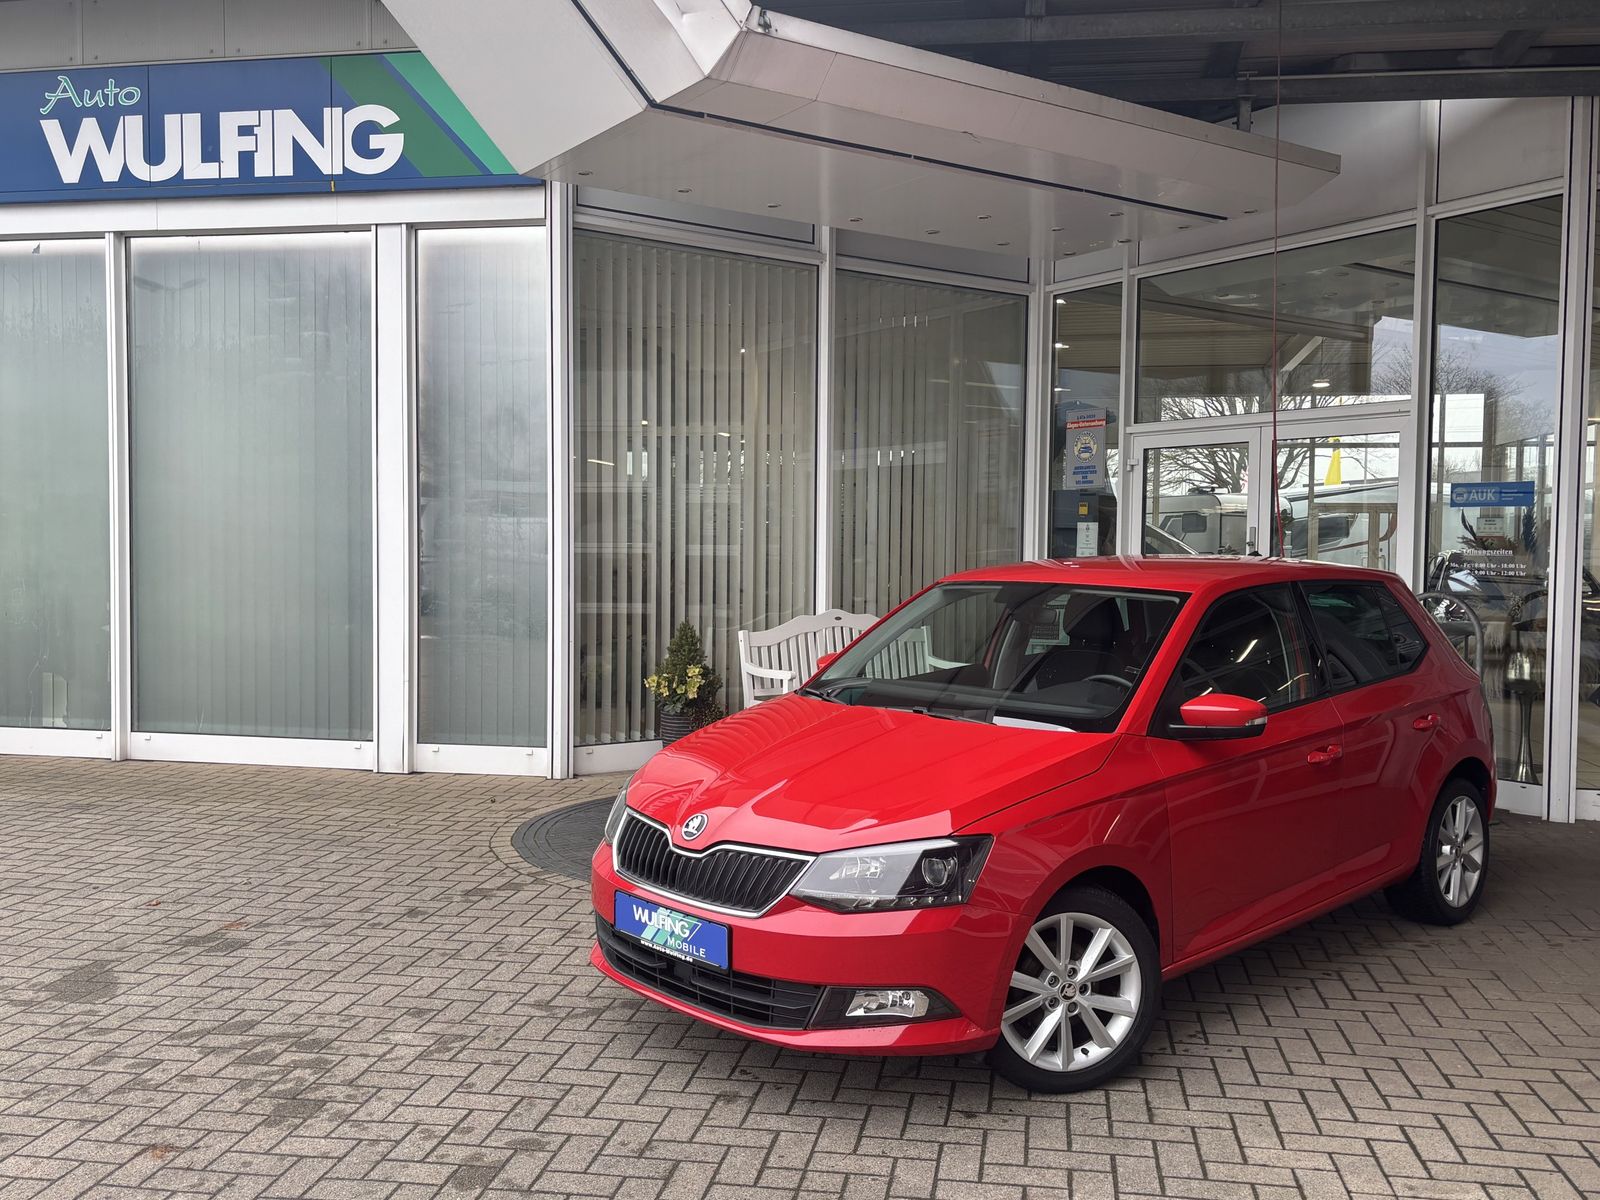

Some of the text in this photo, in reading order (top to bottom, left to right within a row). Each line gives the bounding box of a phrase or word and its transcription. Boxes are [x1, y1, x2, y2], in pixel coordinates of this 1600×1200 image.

[39, 75, 142, 114] Auto
[39, 104, 405, 184] WULFING
[1468, 489, 1496, 501] AUK
[632, 904, 690, 937] WULFING
[667, 935, 706, 958] MOBILE
